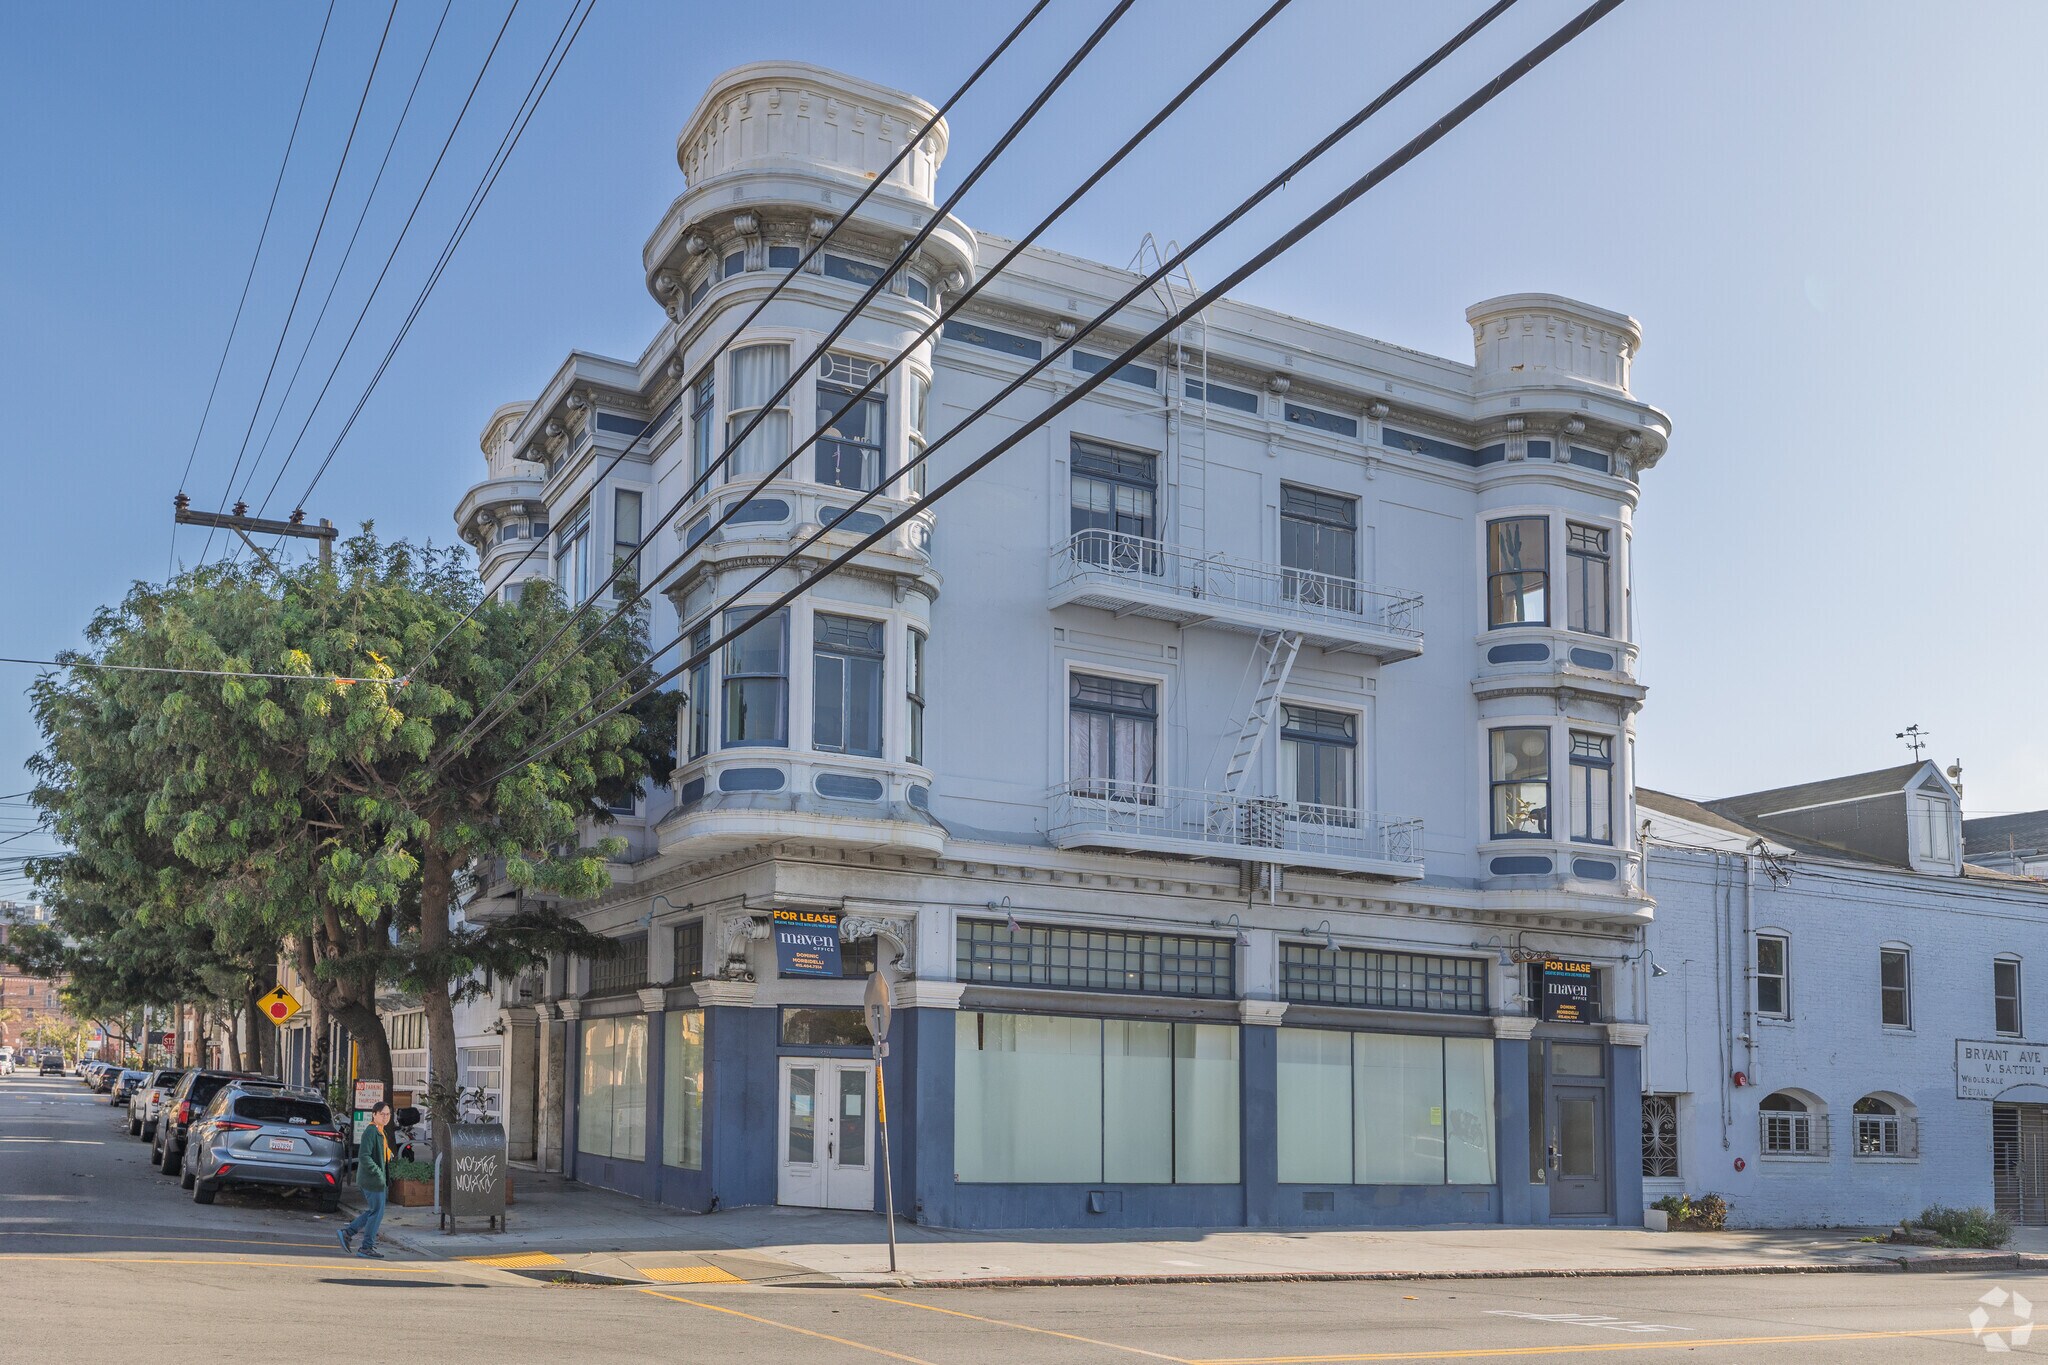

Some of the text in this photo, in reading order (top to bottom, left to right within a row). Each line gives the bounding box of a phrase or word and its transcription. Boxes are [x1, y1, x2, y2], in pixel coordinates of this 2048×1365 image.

[773, 910, 837, 924] FOR LEASE
[780, 932, 834, 947] maven
[1545, 961, 1591, 973] FOR LEASE
[1548, 983, 1587, 996] maven
[1965, 1048, 2041, 1063] BRYANT AVE
[1985, 1063, 1995, 1073] V.
[1999, 1065, 2035, 1076] SATTUI
[356, 1082, 364, 1090] NO
